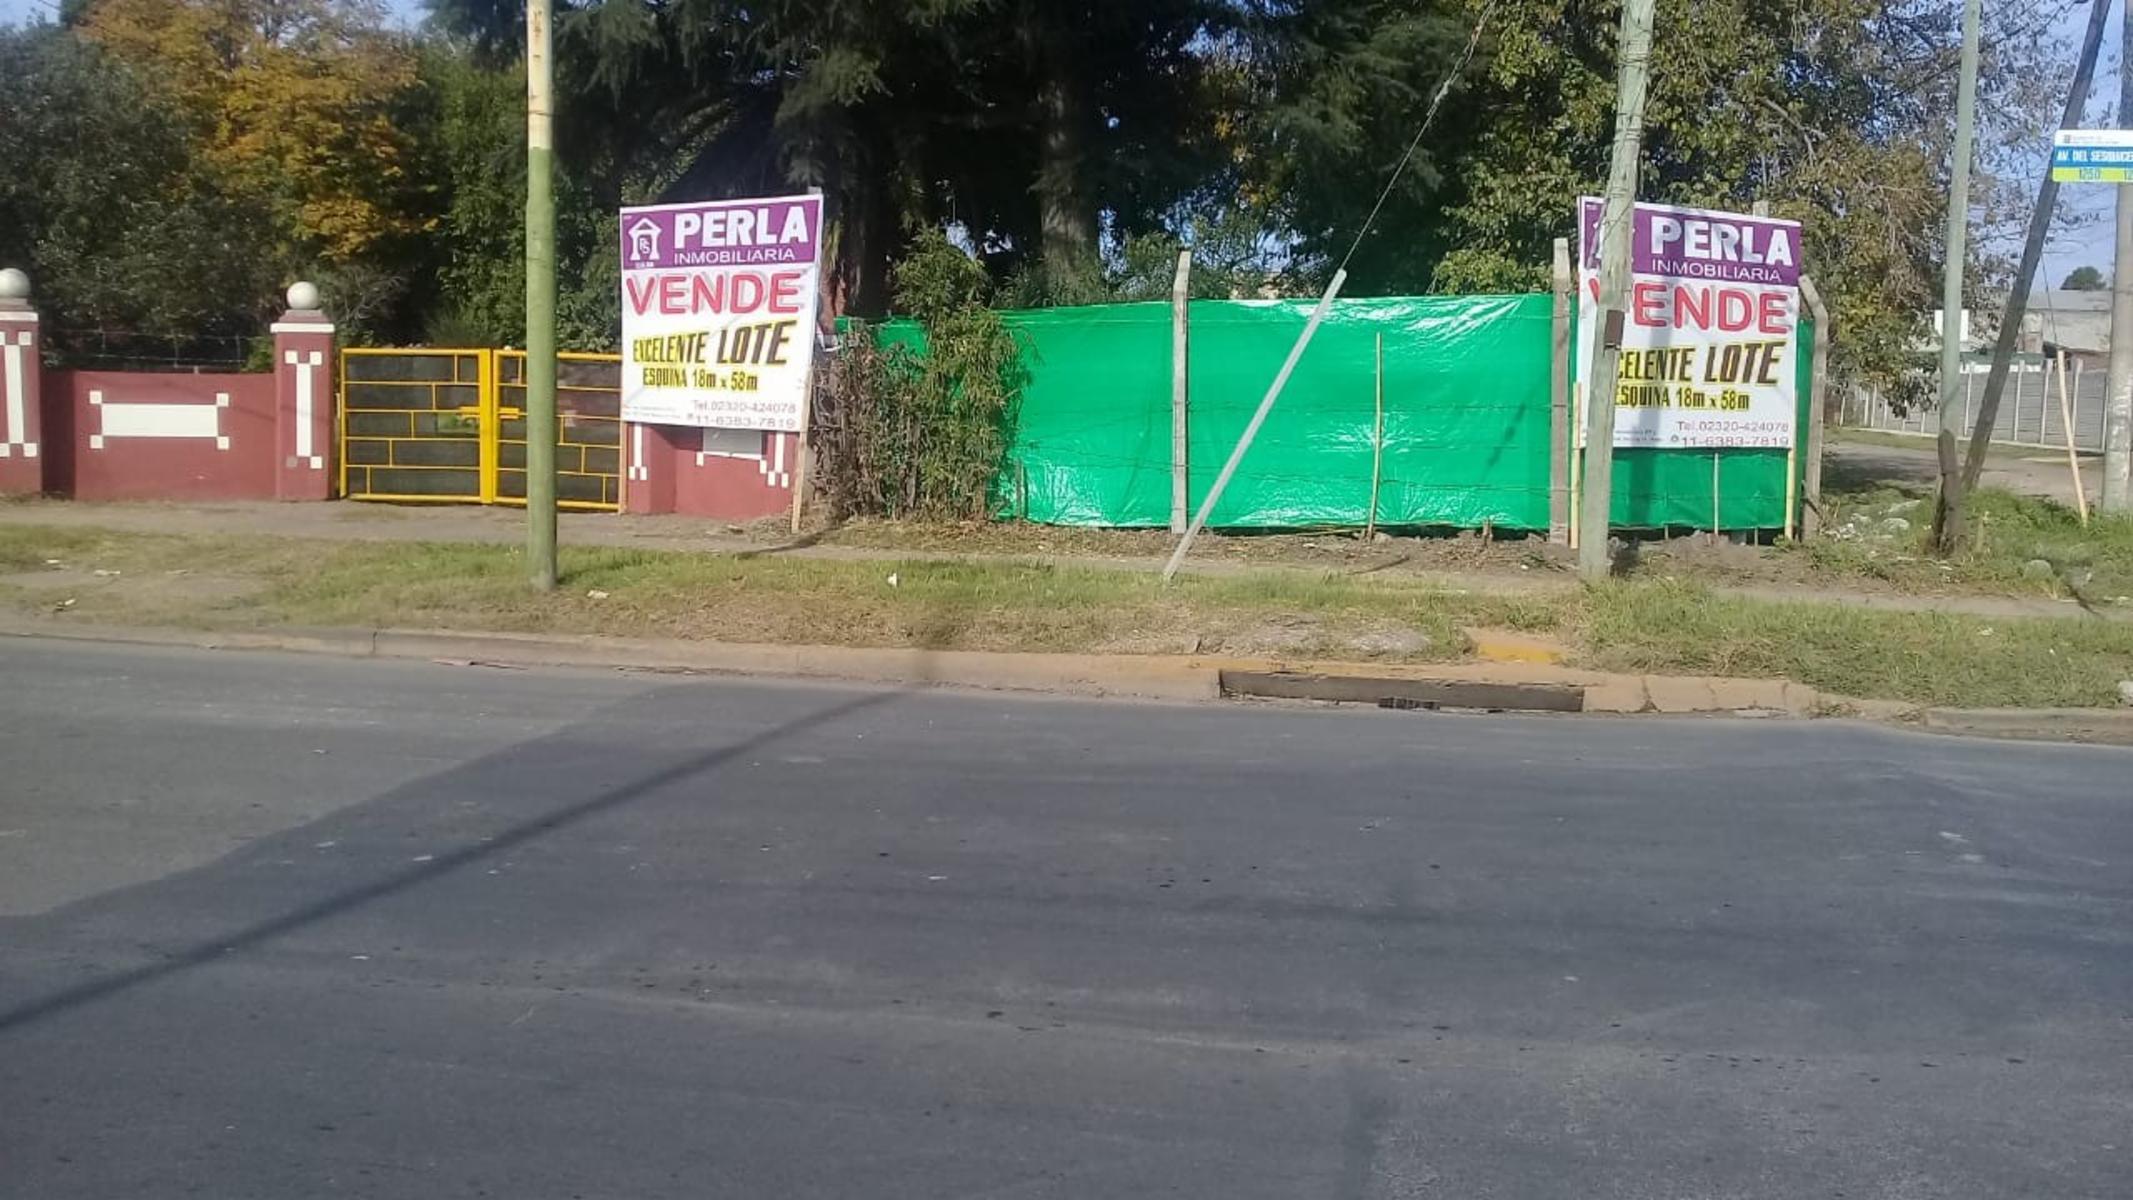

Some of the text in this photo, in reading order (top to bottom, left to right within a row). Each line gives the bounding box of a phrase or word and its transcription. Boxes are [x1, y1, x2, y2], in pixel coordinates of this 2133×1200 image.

[2073, 149, 2087, 161] DEL
[674, 205, 809, 249] PERLA
[1650, 215, 1794, 267] PERLA
[674, 247, 796, 265] INMOBILIARIA
[1652, 258, 1783, 282] INMOBILIARIA
[625, 272, 802, 315] VENDE
[633, 319, 798, 365] EXCELENTE LOTE
[642, 367, 688, 389] ESQUINA
[693, 369, 716, 388] 18m
[731, 371, 758, 391] 58m
[1704, 341, 1787, 385] LOTE
[1676, 387, 1706, 408] 18m
[1721, 390, 1750, 410] 58m
